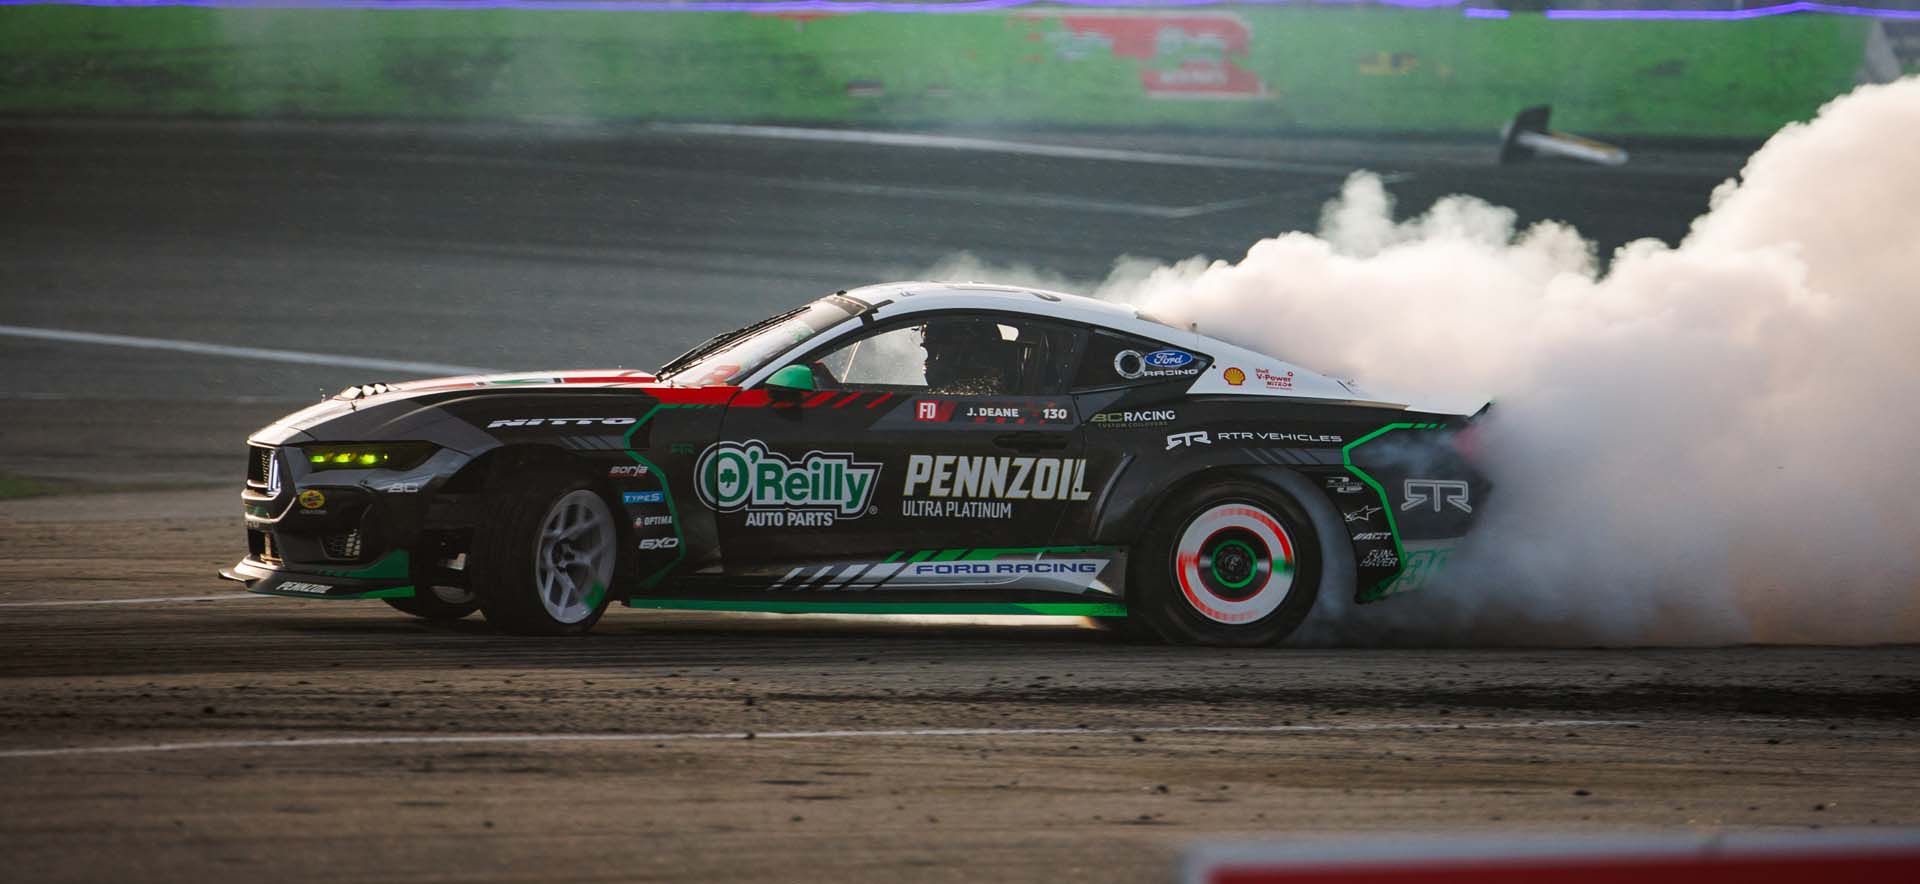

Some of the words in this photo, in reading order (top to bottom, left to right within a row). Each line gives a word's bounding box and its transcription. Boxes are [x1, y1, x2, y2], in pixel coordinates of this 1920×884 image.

[1153, 352, 1184, 364] Ford
[1144, 368, 1199, 377] RACING
[919, 402, 936, 419] FD
[966, 407, 977, 417] J.
[979, 407, 1019, 417] DEANE
[1042, 408, 1067, 419] 130
[487, 417, 637, 428] NITTO
[1217, 432, 1253, 440] RTR
[1255, 432, 1343, 442] VEHICLES
[704, 450, 869, 509] O'Reilly
[903, 454, 1092, 500] PENNZOIL
[902, 500, 943, 517] ULTRA
[946, 501, 1012, 519] PLATINUM
[644, 516, 672, 525] OPTIMA
[745, 511, 784, 526] AUTO
[787, 511, 833, 526] PARTS
[916, 564, 990, 575] FORD
[996, 563, 1097, 574] RACING
